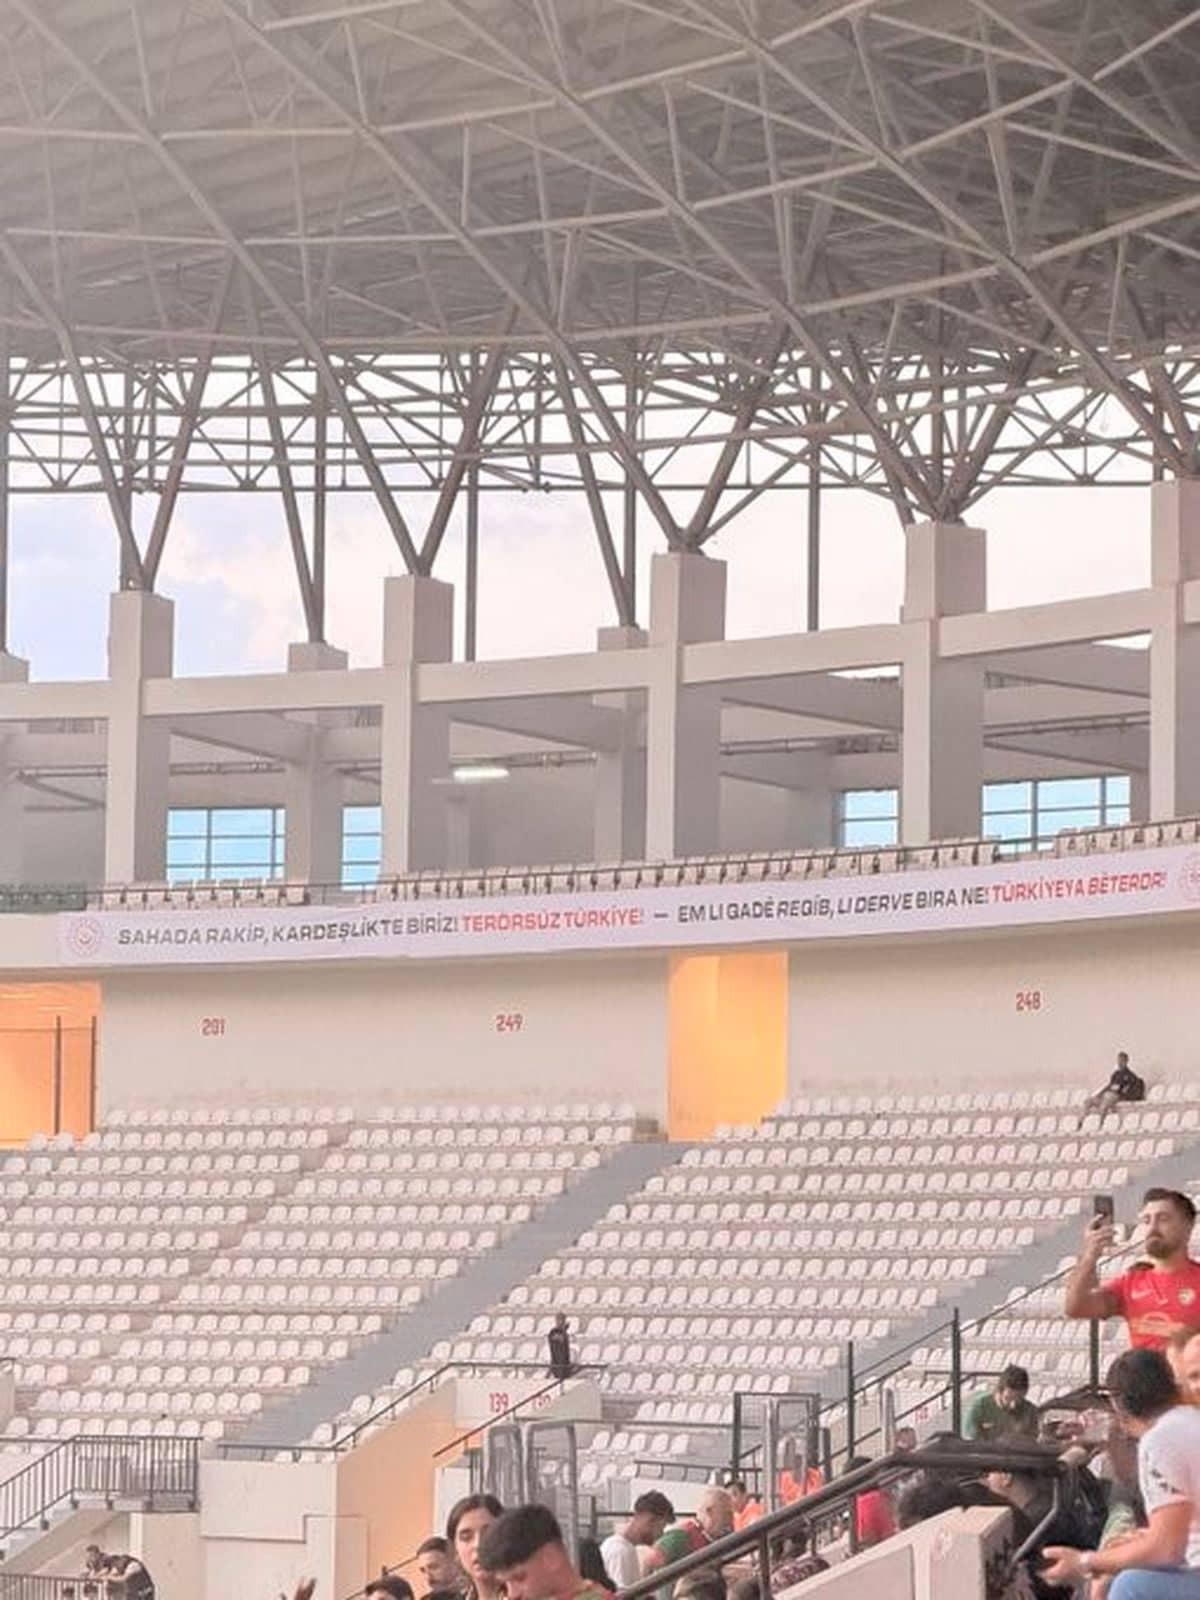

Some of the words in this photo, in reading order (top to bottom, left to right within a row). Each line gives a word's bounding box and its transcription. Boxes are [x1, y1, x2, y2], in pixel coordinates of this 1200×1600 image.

[119, 928, 201, 946] SAHADA
[206, 923, 270, 945] RAKİP,
[273, 914, 403, 943] KARDEŞLİKTE
[407, 911, 458, 934] BİRİZ!
[678, 904, 706, 922] EM
[709, 902, 723, 921] LI
[838, 897, 852, 914] LI
[854, 891, 913, 914] DERVE
[915, 889, 958, 909] BIRA
[1016, 991, 1041, 1011] 248
[202, 1018, 225, 1036] 201
[496, 1013, 523, 1032] 249
[489, 1392, 509, 1413] 139
